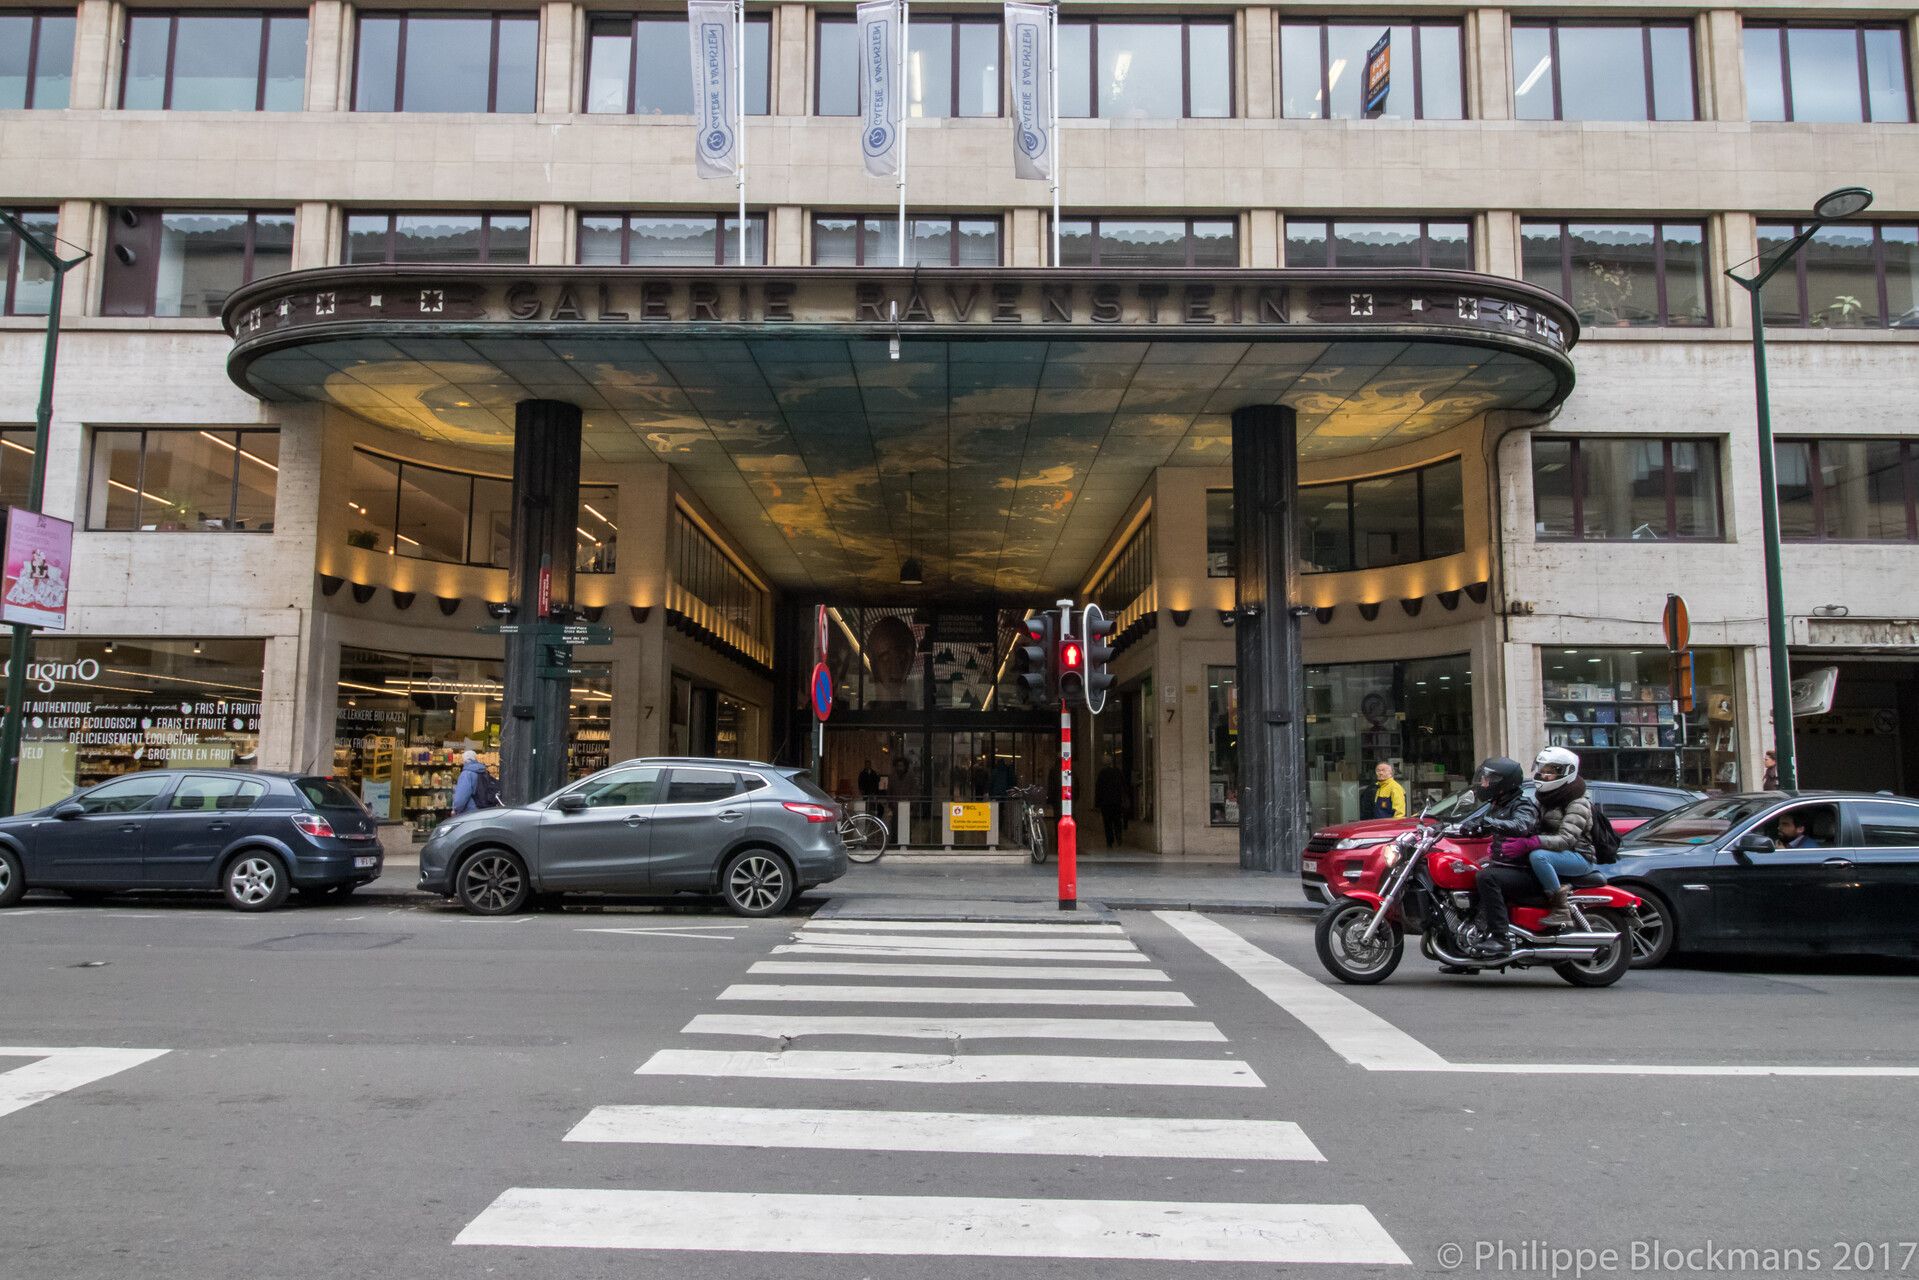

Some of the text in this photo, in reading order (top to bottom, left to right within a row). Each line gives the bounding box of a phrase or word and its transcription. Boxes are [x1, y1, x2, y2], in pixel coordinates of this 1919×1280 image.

[503, 281, 1290, 323] GALERIE RAVENSTEIN
[32, 701, 92, 714] AUTHENTIQUE
[195, 702, 215, 715] FRIS
[217, 702, 228, 715] EN
[644, 705, 654, 720] 7
[48, 716, 81, 729] LEKKER
[83, 716, 137, 729] ECOLOGISCH
[156, 717, 182, 730] FRAIS
[184, 717, 194, 730] ET
[196, 717, 227, 730] FRUITÉ
[1166, 709, 1175, 723] 7
[69, 732, 143, 745] DÉLICIEUSEMENT
[22, 747, 43, 759] VELD
[147, 748, 236, 760] GROENTEN EN FRUIT
